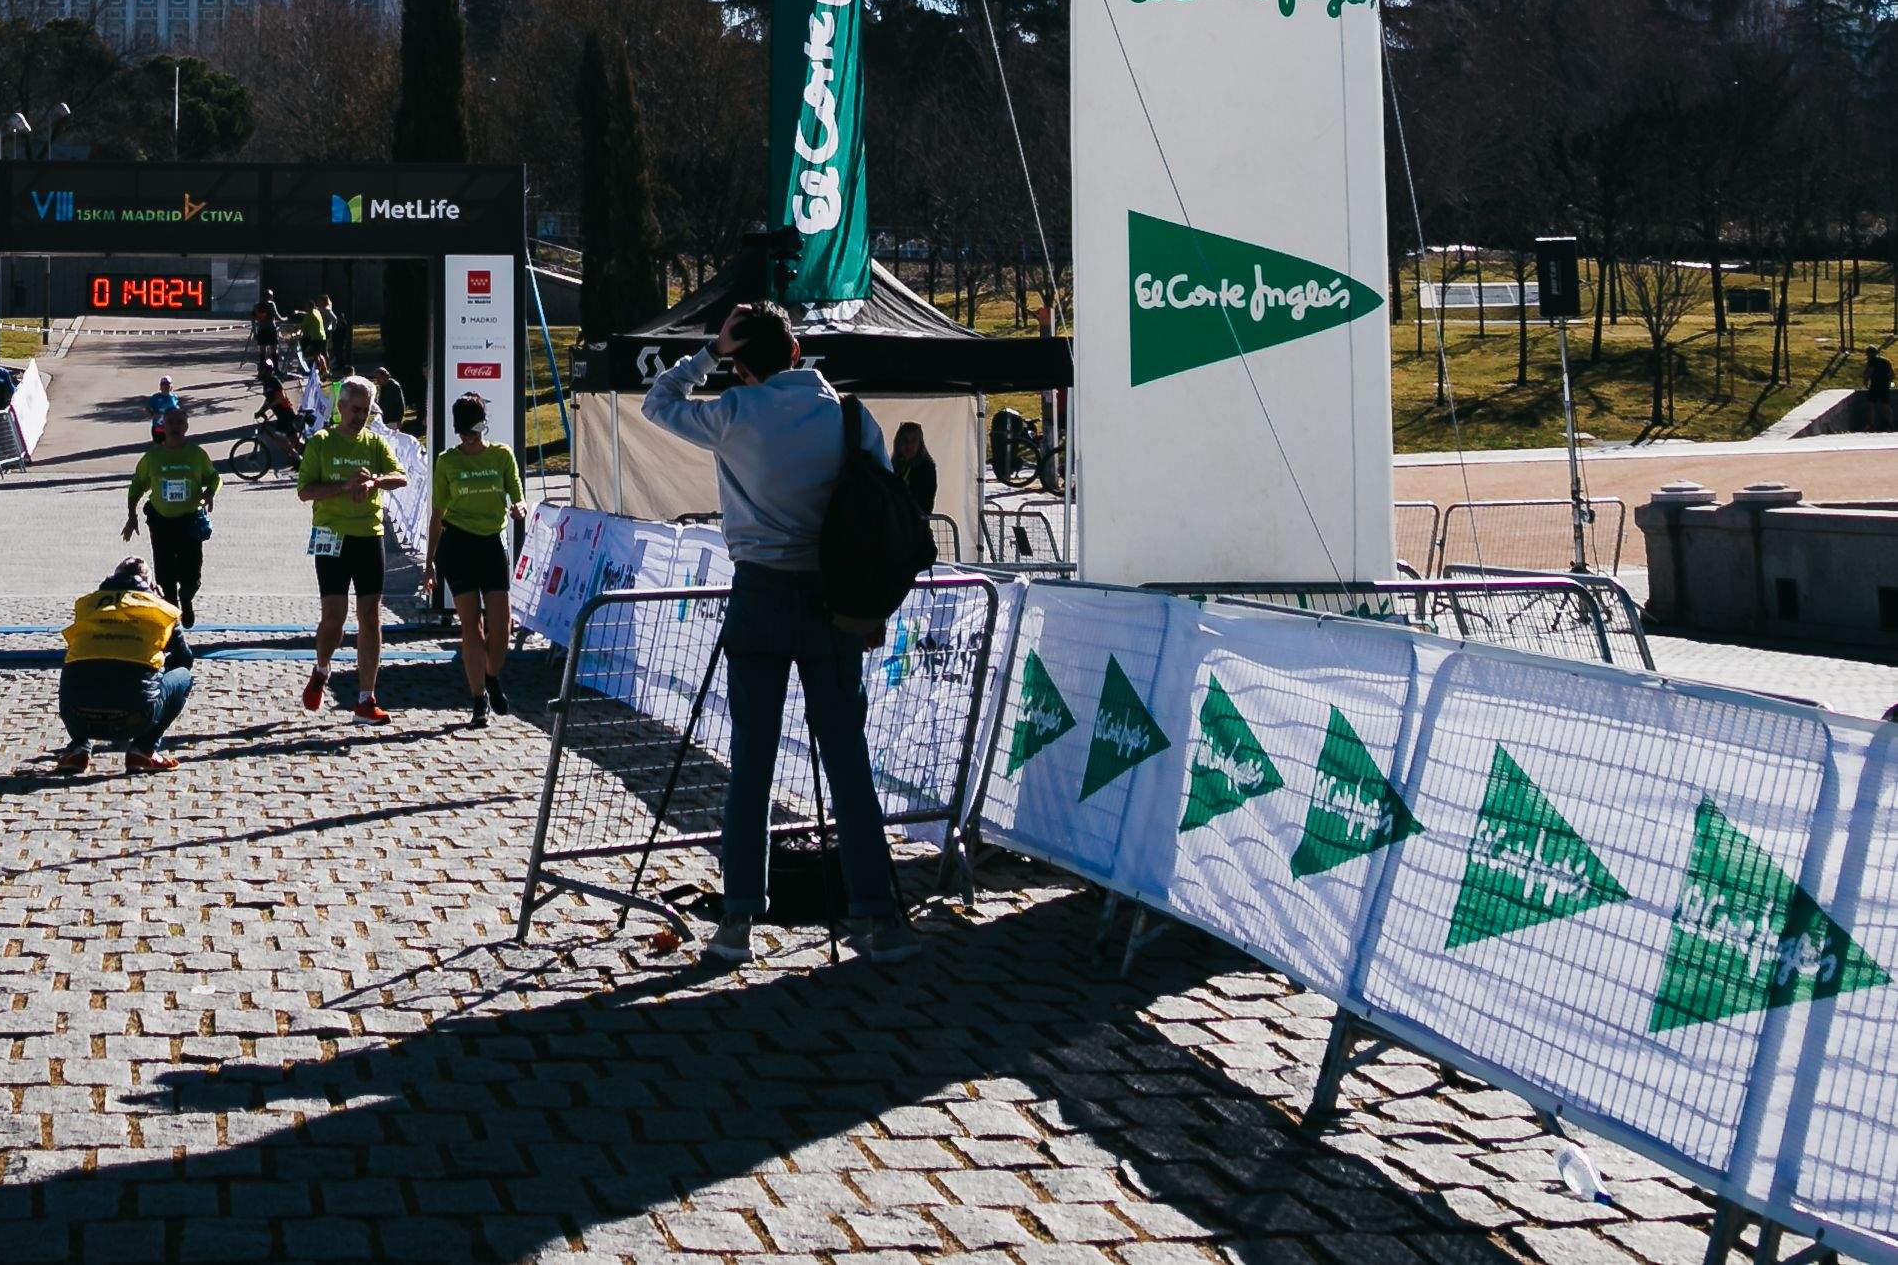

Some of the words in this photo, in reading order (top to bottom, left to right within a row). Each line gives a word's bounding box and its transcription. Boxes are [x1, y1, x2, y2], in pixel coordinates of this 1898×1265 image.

[795, 11, 839, 164] Corte
[30, 190, 74, 222] VIII
[76, 209, 116, 221] 15KM
[121, 209, 183, 222] MADRID
[370, 198, 461, 220] MetLife
[792, 166, 842, 235] El
[92, 277, 110, 308] 0
[1134, 272, 1165, 310] El
[1166, 273, 1246, 310] Corte
[1250, 264, 1351, 322] Inglés
